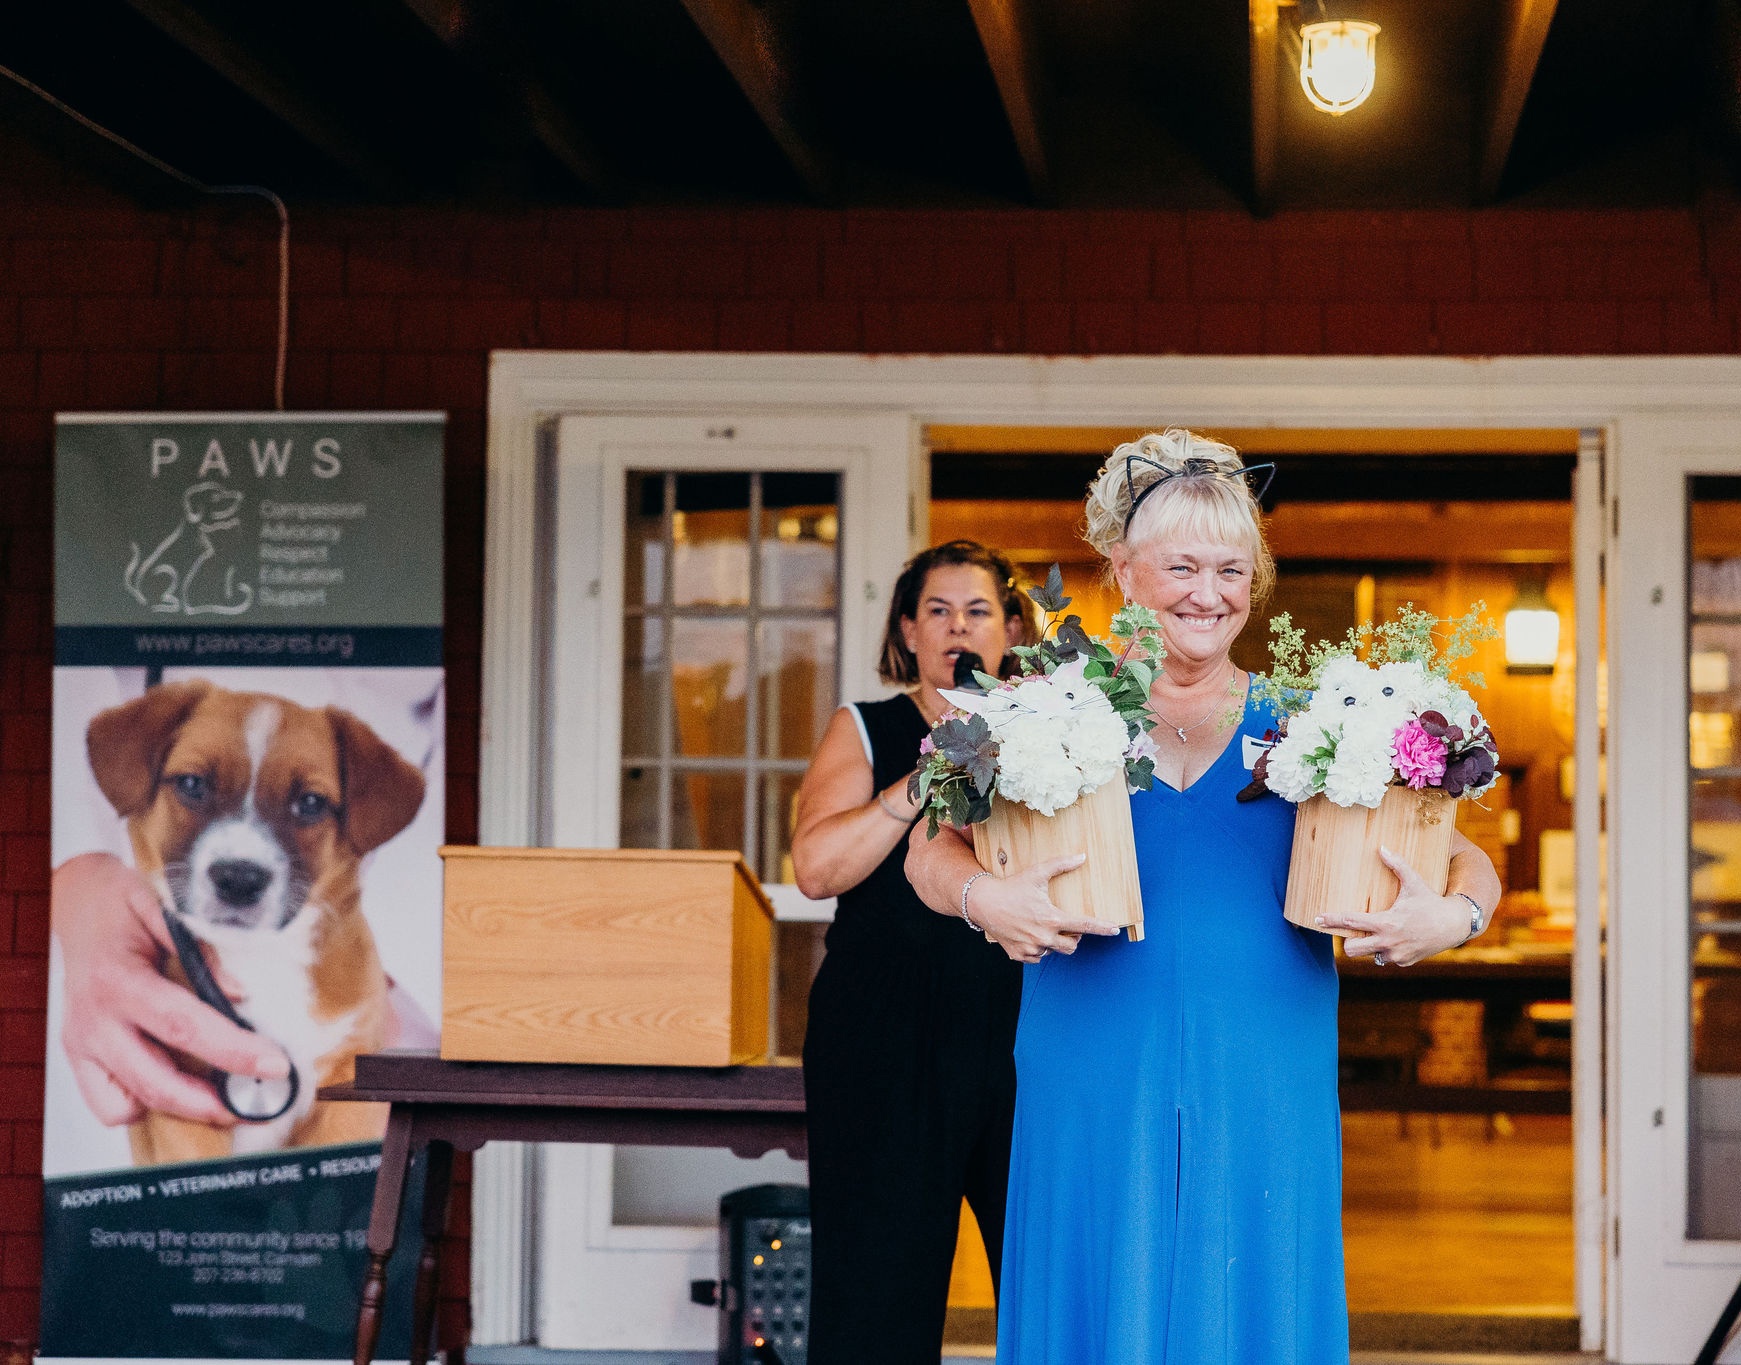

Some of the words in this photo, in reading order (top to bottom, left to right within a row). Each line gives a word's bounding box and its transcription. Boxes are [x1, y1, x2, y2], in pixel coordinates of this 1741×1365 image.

[151, 438, 341, 479] PAWS
[259, 566, 344, 585] Education
[135, 632, 354, 658] www.pawscares.org
[60, 1183, 142, 1208] ADOPTION
[158, 1169, 257, 1197] VETERINARY
[259, 1163, 303, 1184] CARE
[319, 1154, 382, 1177] RESOUR
[89, 1227, 155, 1251] Serving
[158, 1229, 187, 1248] the
[190, 1229, 289, 1251] community
[291, 1231, 340, 1250] since
[344, 1229, 367, 1250] 19
